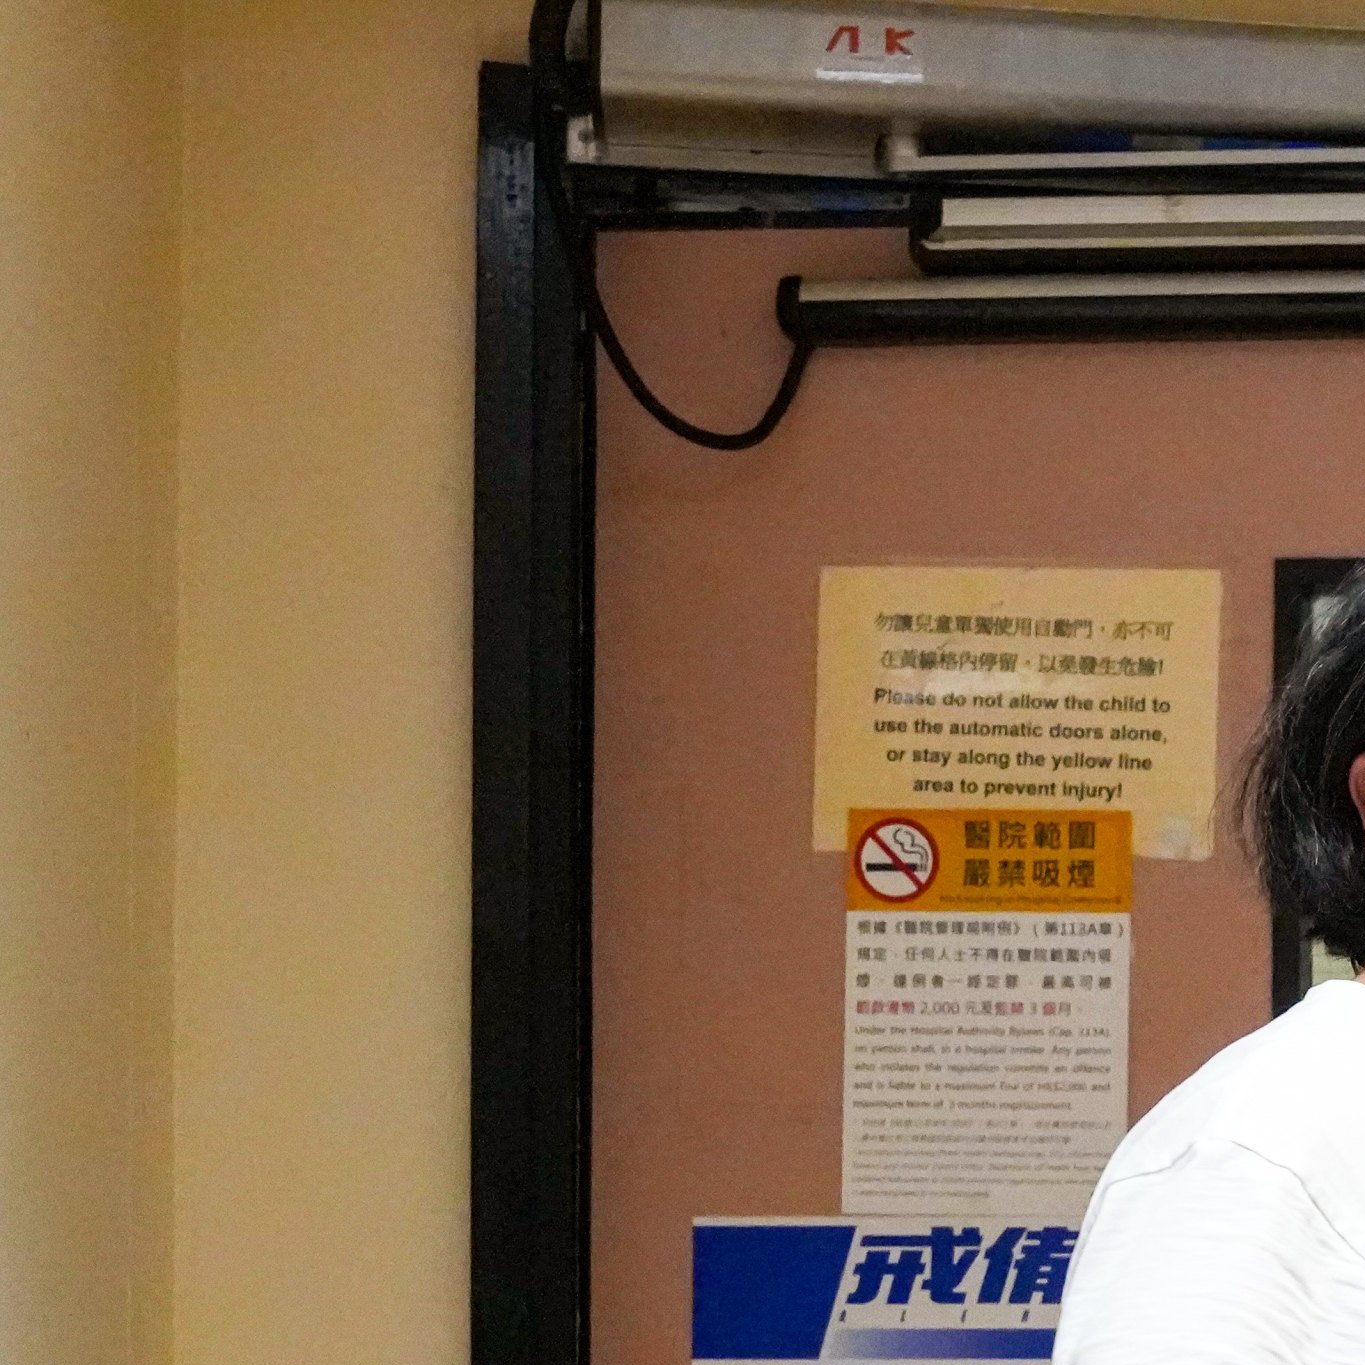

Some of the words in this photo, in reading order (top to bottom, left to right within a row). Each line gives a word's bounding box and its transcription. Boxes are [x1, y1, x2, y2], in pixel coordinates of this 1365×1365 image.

[874, 687, 935, 706] Please
[943, 691, 966, 706] do
[973, 692, 1002, 708] not
[1009, 692, 1057, 709] allow
[1064, 693, 1092, 711] the
[1099, 694, 1144, 712] child
[1152, 696, 1170, 713] to
[874, 719, 907, 734] use
[914, 718, 943, 735] the
[949, 719, 1042, 738] automatic
[1049, 722, 1103, 740] doors
[1110, 724, 1167, 744] alone,
[887, 749, 904, 762] or
[913, 747, 951, 767] stay
[957, 747, 1010, 770] along
[1016, 750, 1045, 767] the
[1051, 751, 1112, 772] yellow
[1118, 753, 1151, 771] line
[913, 779, 953, 793] area
[960, 778, 978, 795] to
[984, 779, 1056, 800] prevent
[1063, 780, 1122, 802] injury!
[964, 820, 1095, 850] 醫院範圍
[963, 858, 1095, 888] 嚴禁吸煙
